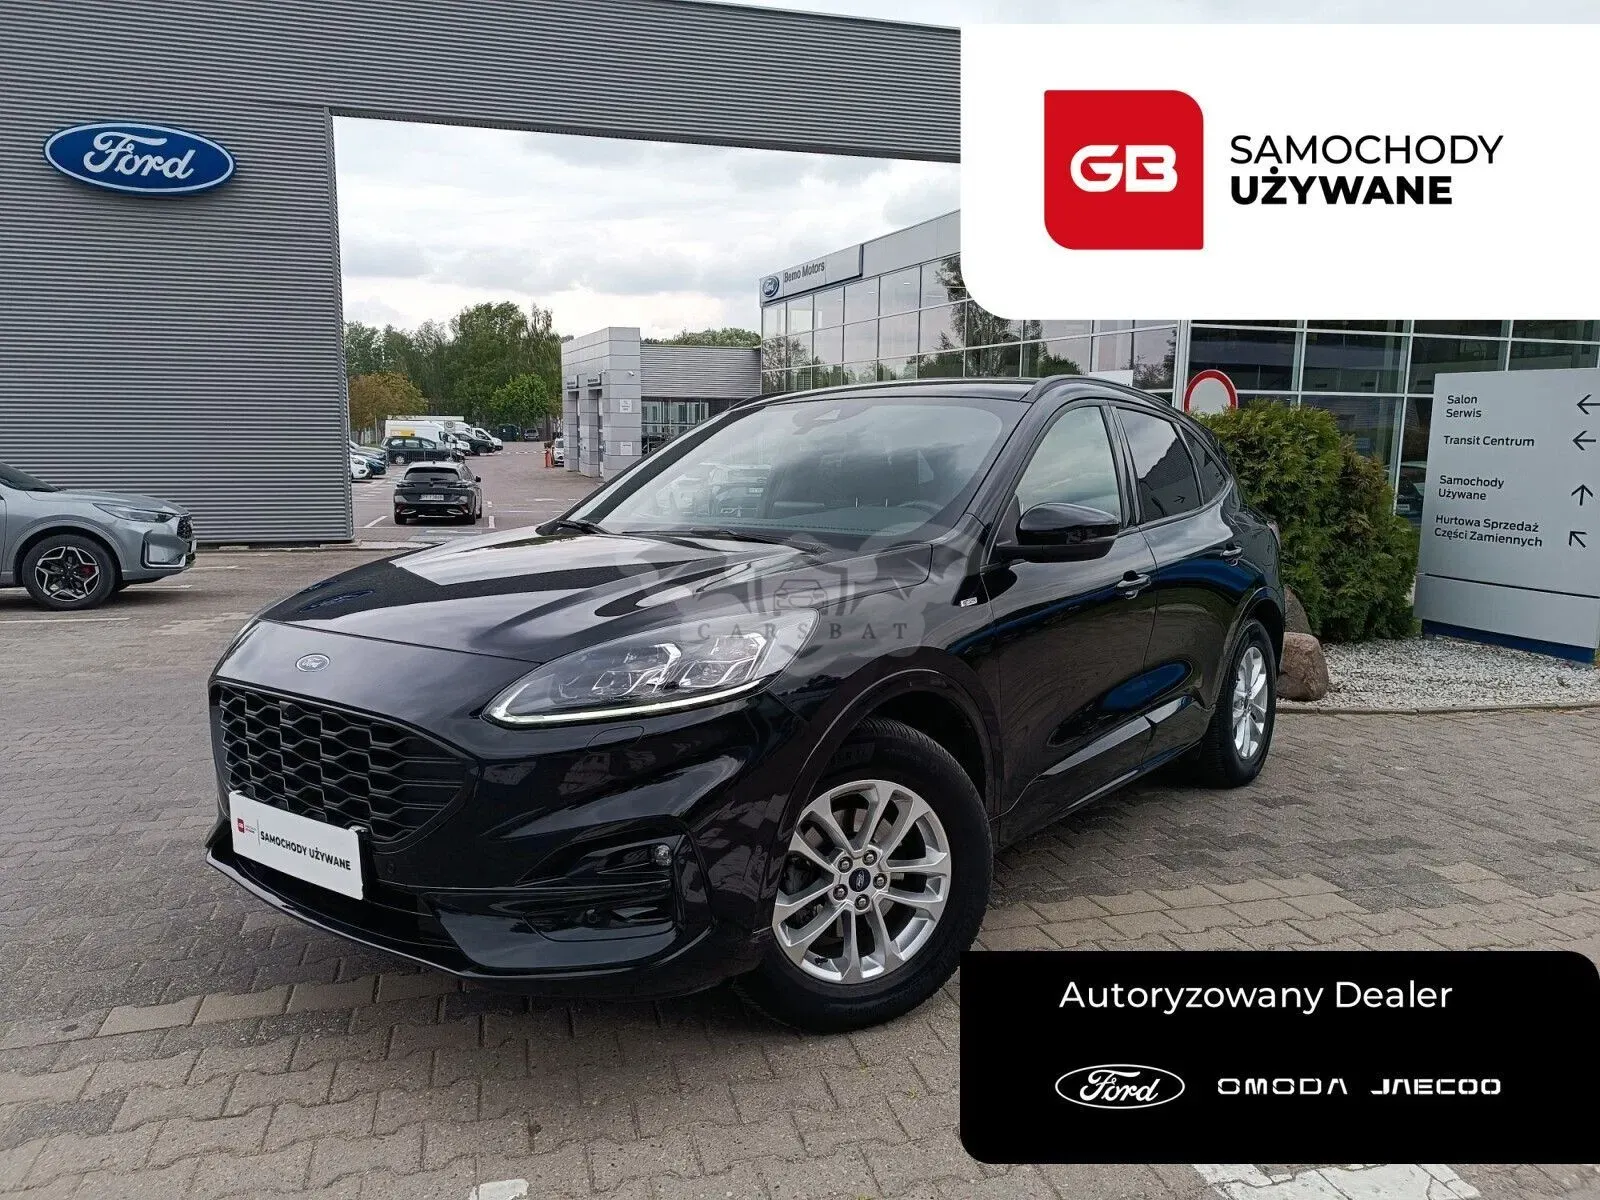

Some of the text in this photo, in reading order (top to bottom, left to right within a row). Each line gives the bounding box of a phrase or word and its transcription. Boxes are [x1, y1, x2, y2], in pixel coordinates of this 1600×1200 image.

[83, 131, 196, 179] Ford
[802, 262, 825, 277] Motors
[1447, 395, 1478, 405] Salon
[1446, 408, 1482, 418] Serwis
[1444, 435, 1535, 447] Transit Centrum
[1439, 475, 1504, 489] Samochody
[1438, 488, 1487, 501] Używane
[1435, 514, 1539, 533] Hurtowa Sprzedaż
[1434, 527, 1543, 548] Części Zamiennych
[260, 831, 352, 871] SAMOCHODY UŻYWANE
